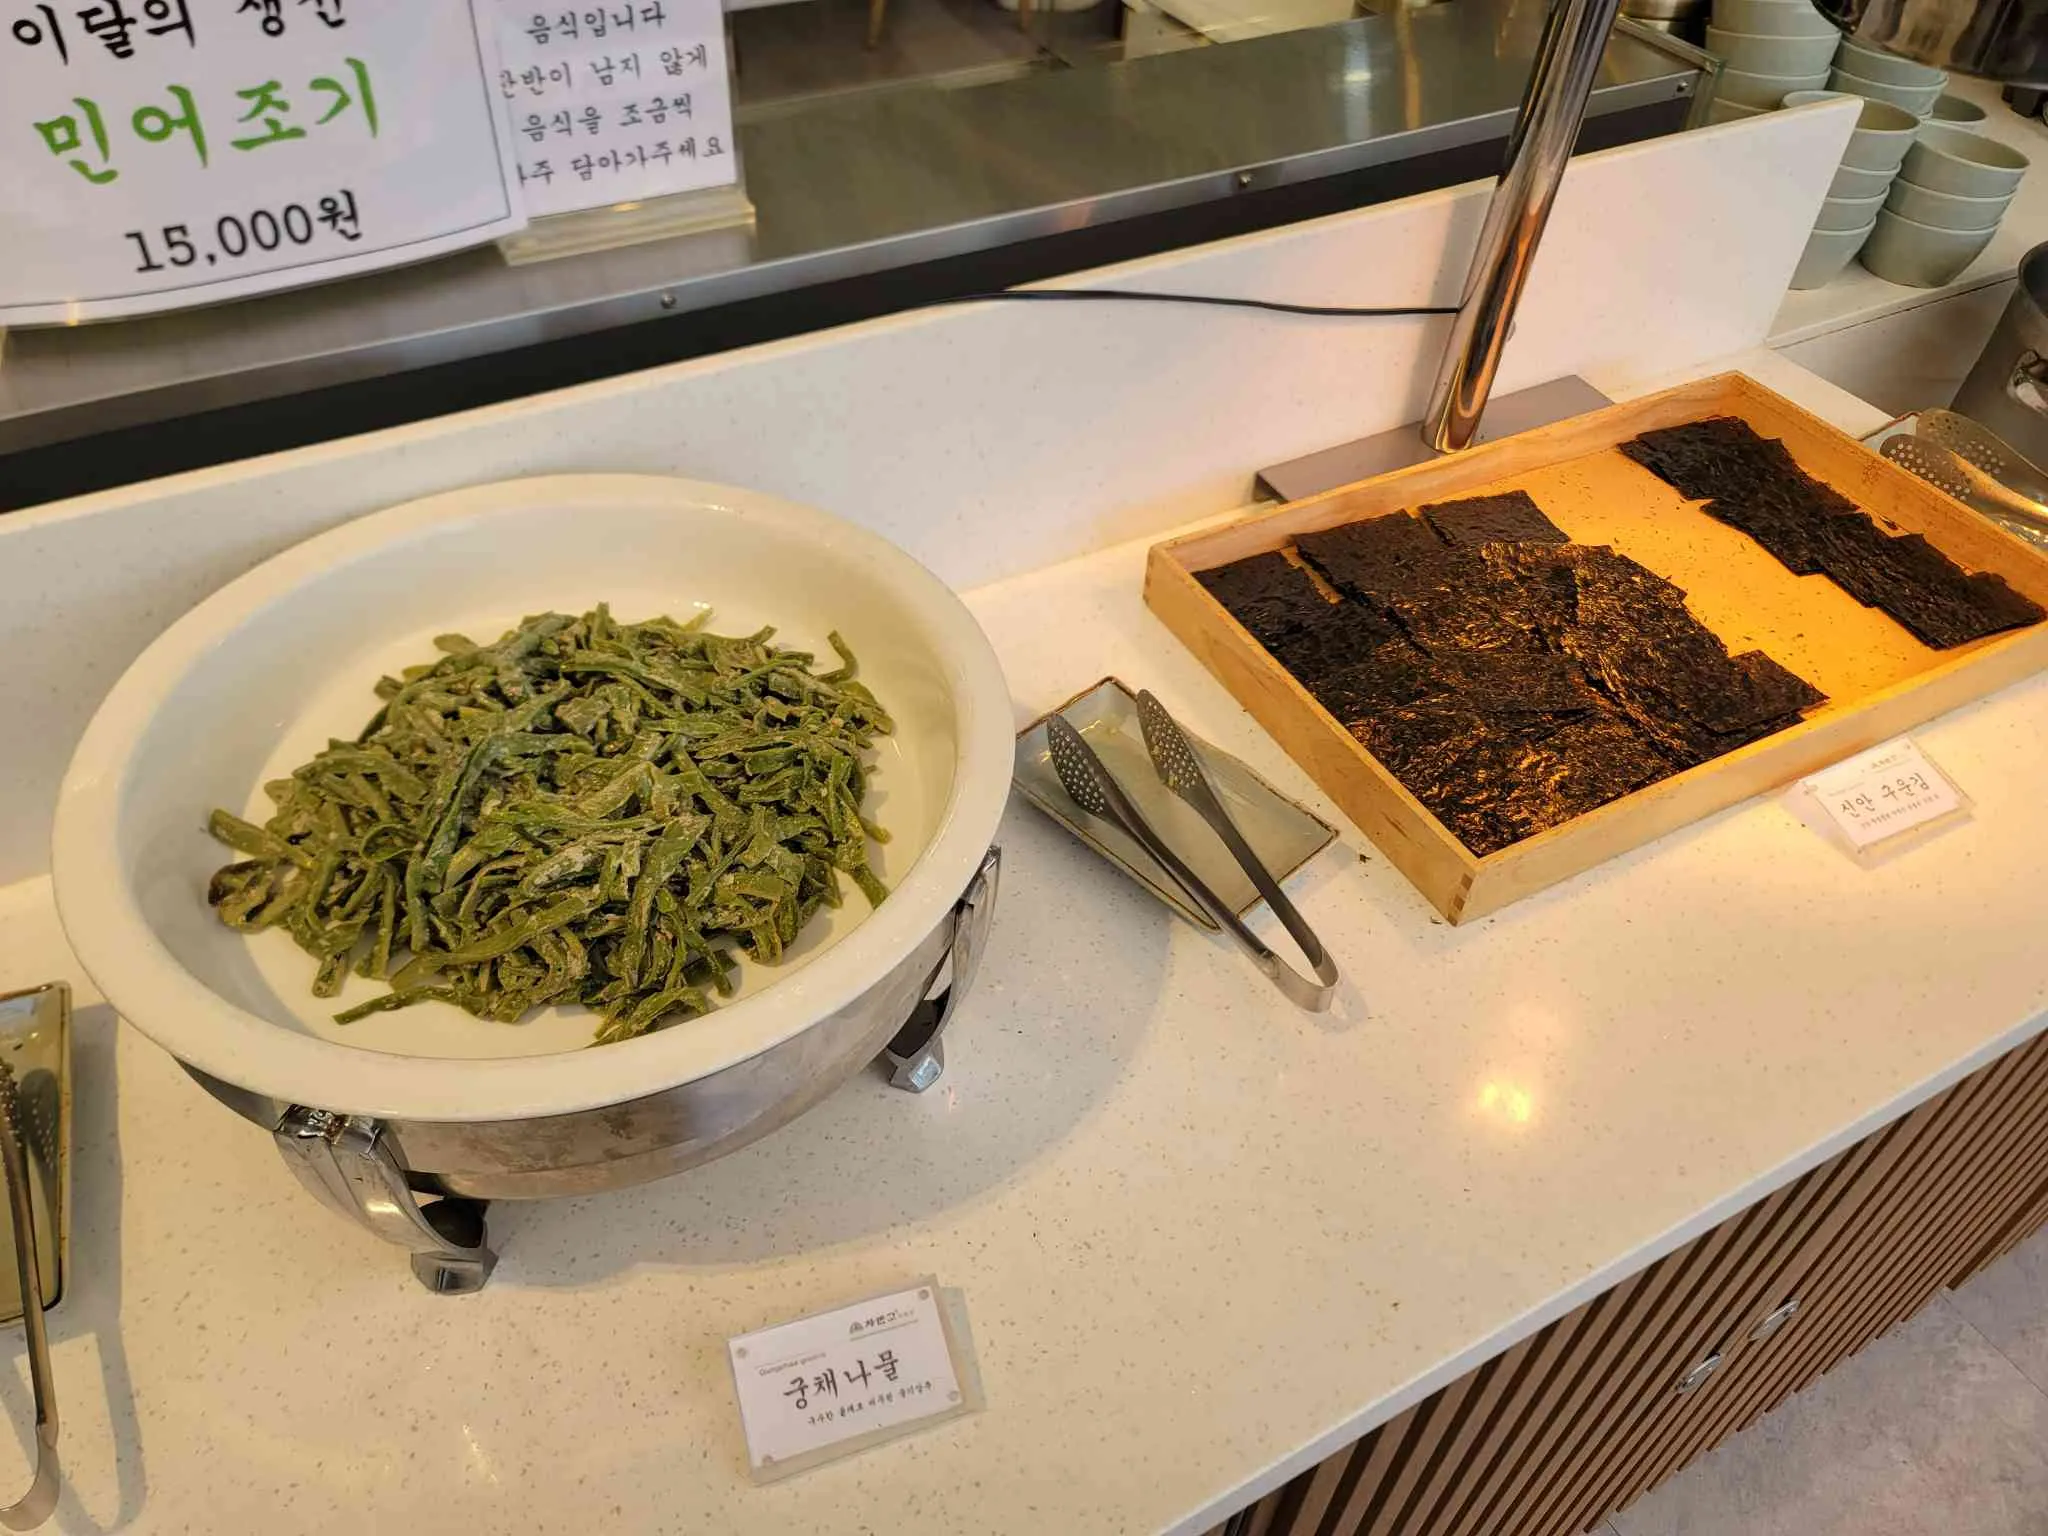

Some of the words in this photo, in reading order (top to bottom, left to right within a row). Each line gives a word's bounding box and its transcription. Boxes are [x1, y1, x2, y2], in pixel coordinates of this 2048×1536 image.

[12, 0, 196, 66] 이달의
[526, 1, 666, 44] 음식입니다
[590, 52, 641, 86] 남지
[660, 43, 708, 76] 않게
[33, 57, 378, 185] 민어조기
[521, 106, 602, 142] 음식을
[619, 92, 692, 125] 조금씩
[571, 136, 725, 181] 담아가주세요
[125, 189, 362, 273] 15,000원
[1840, 793, 1876, 818] 신안
[1881, 772, 1930, 801] 구운김
